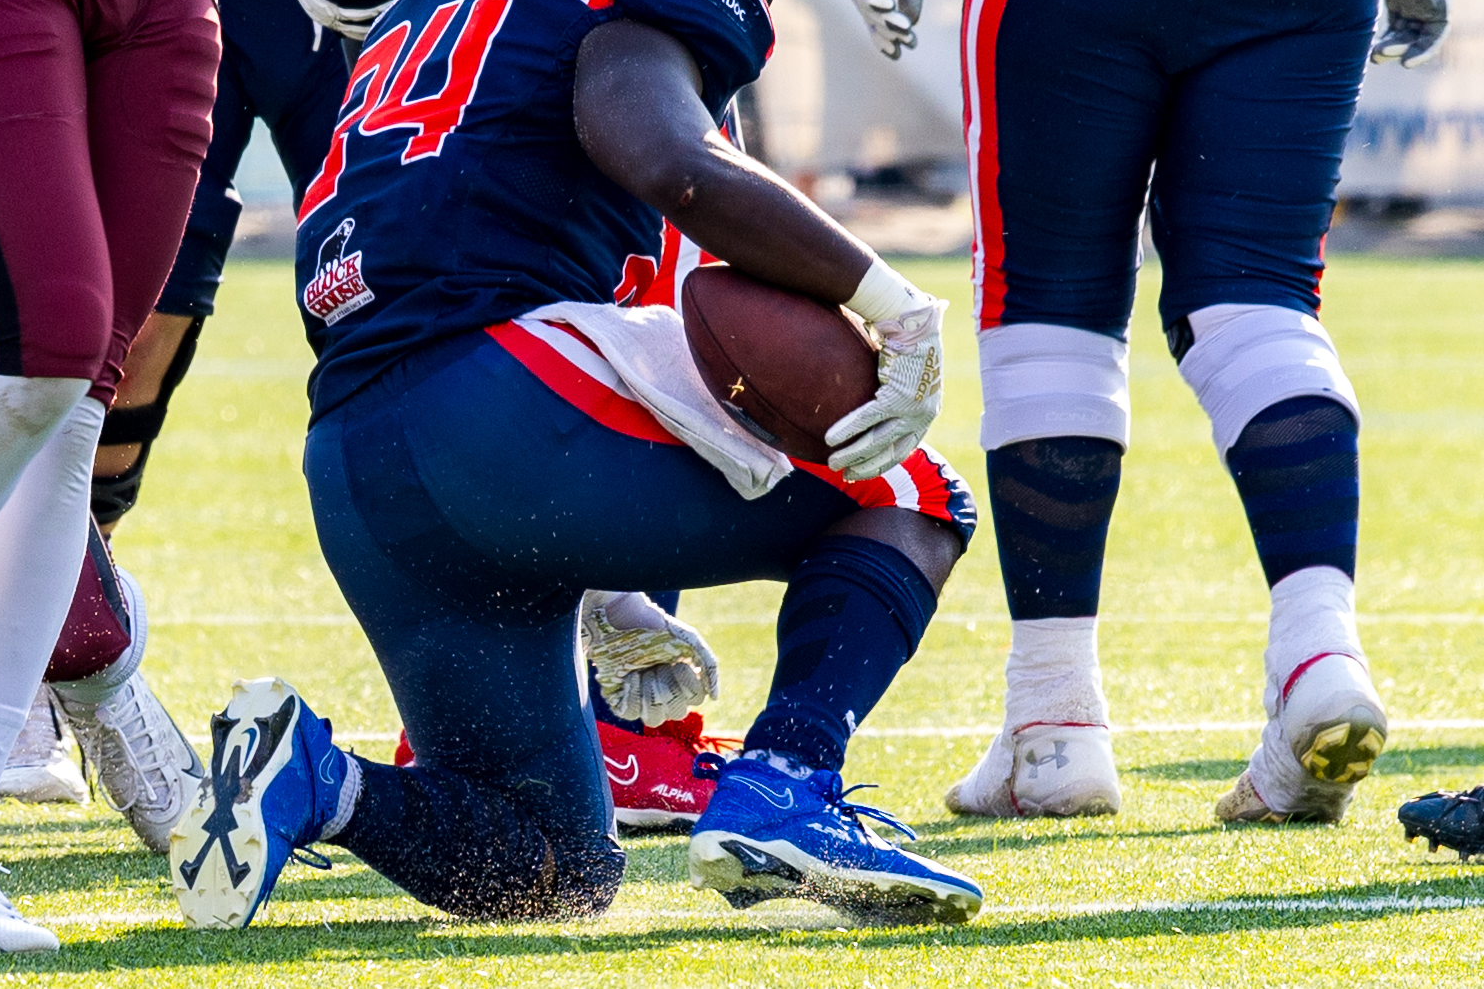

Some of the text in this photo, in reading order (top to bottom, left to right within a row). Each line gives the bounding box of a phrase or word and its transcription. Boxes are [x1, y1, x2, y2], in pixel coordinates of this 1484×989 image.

[306, 254, 360, 305] BLOCK
[309, 272, 368, 318] HOUSE
[915, 346, 936, 403] adidas
[650, 783, 695, 804] ALPHA
